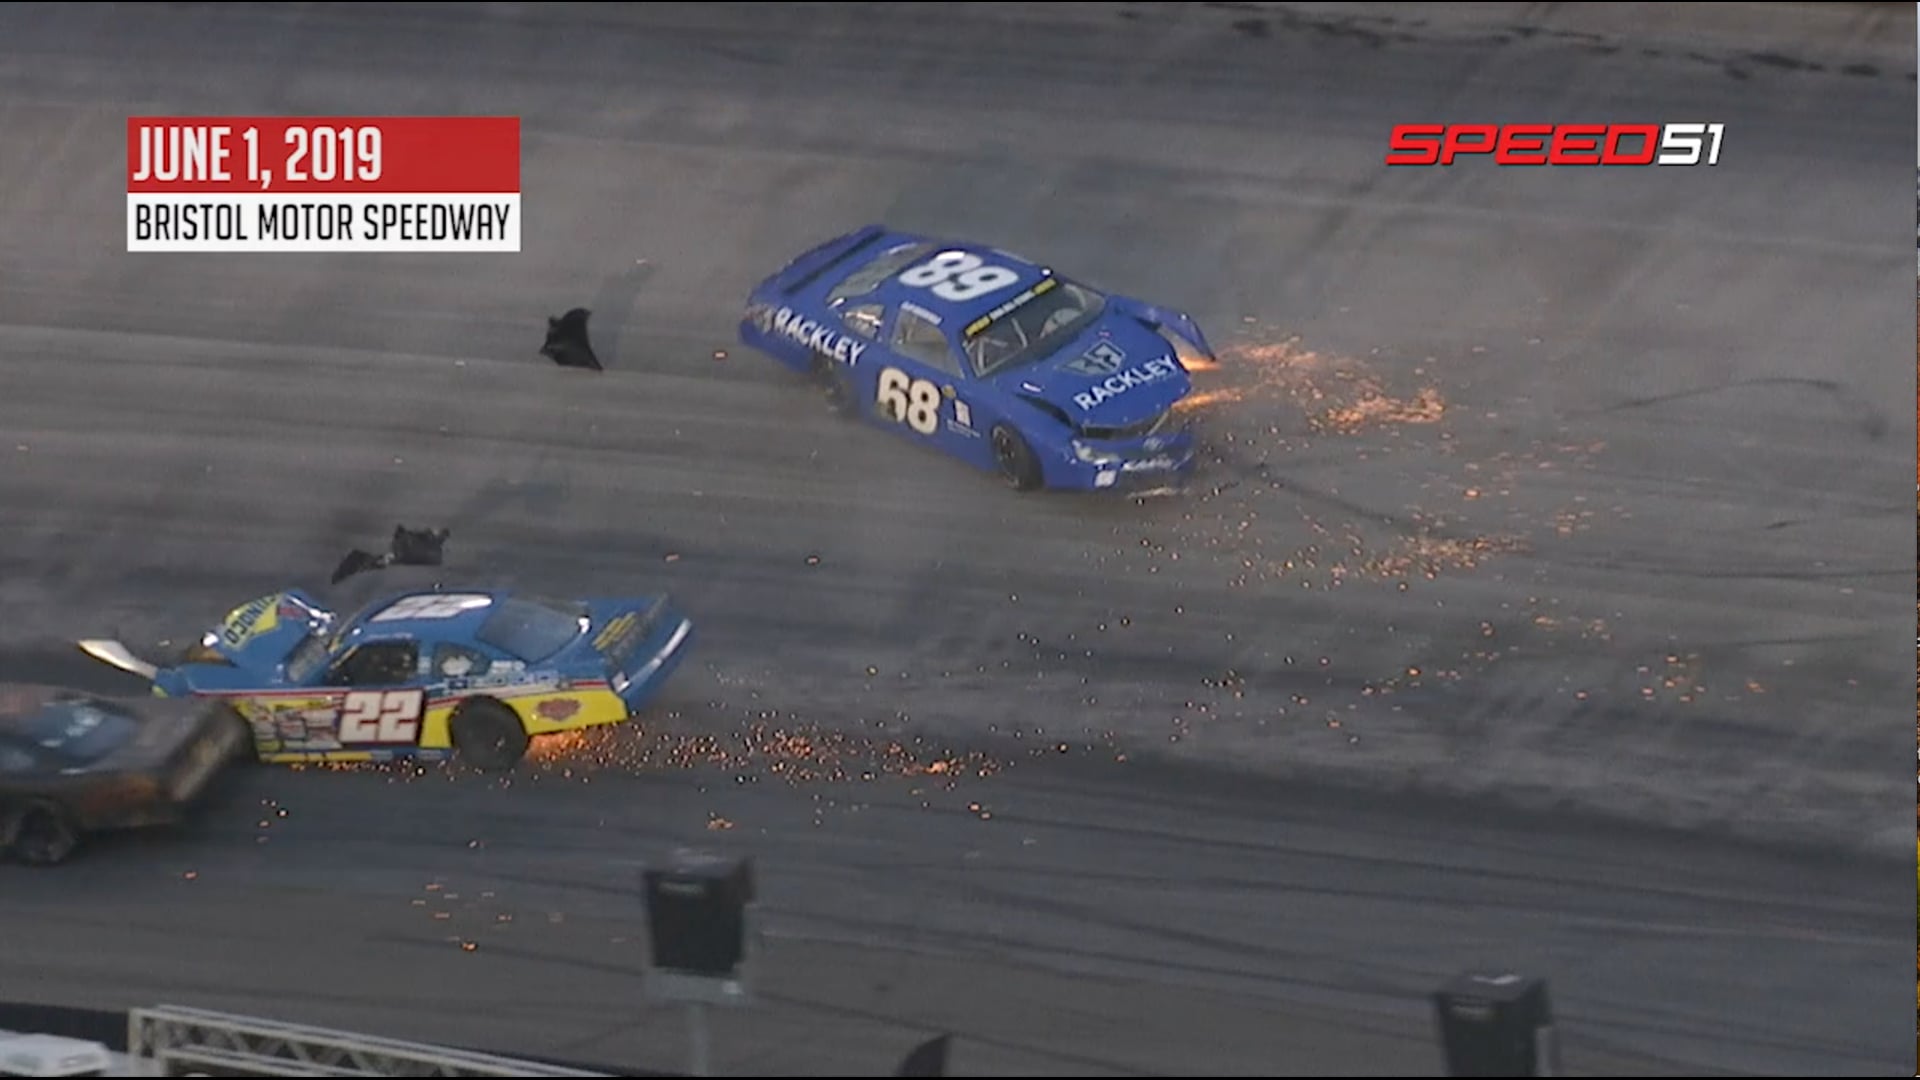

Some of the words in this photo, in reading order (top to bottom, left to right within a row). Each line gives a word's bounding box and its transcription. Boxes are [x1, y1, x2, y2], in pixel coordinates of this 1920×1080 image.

[774, 306, 866, 366] RACKLEY
[876, 366, 941, 435] 68
[1073, 354, 1176, 411] RACKLEY
[339, 690, 424, 743] 22
